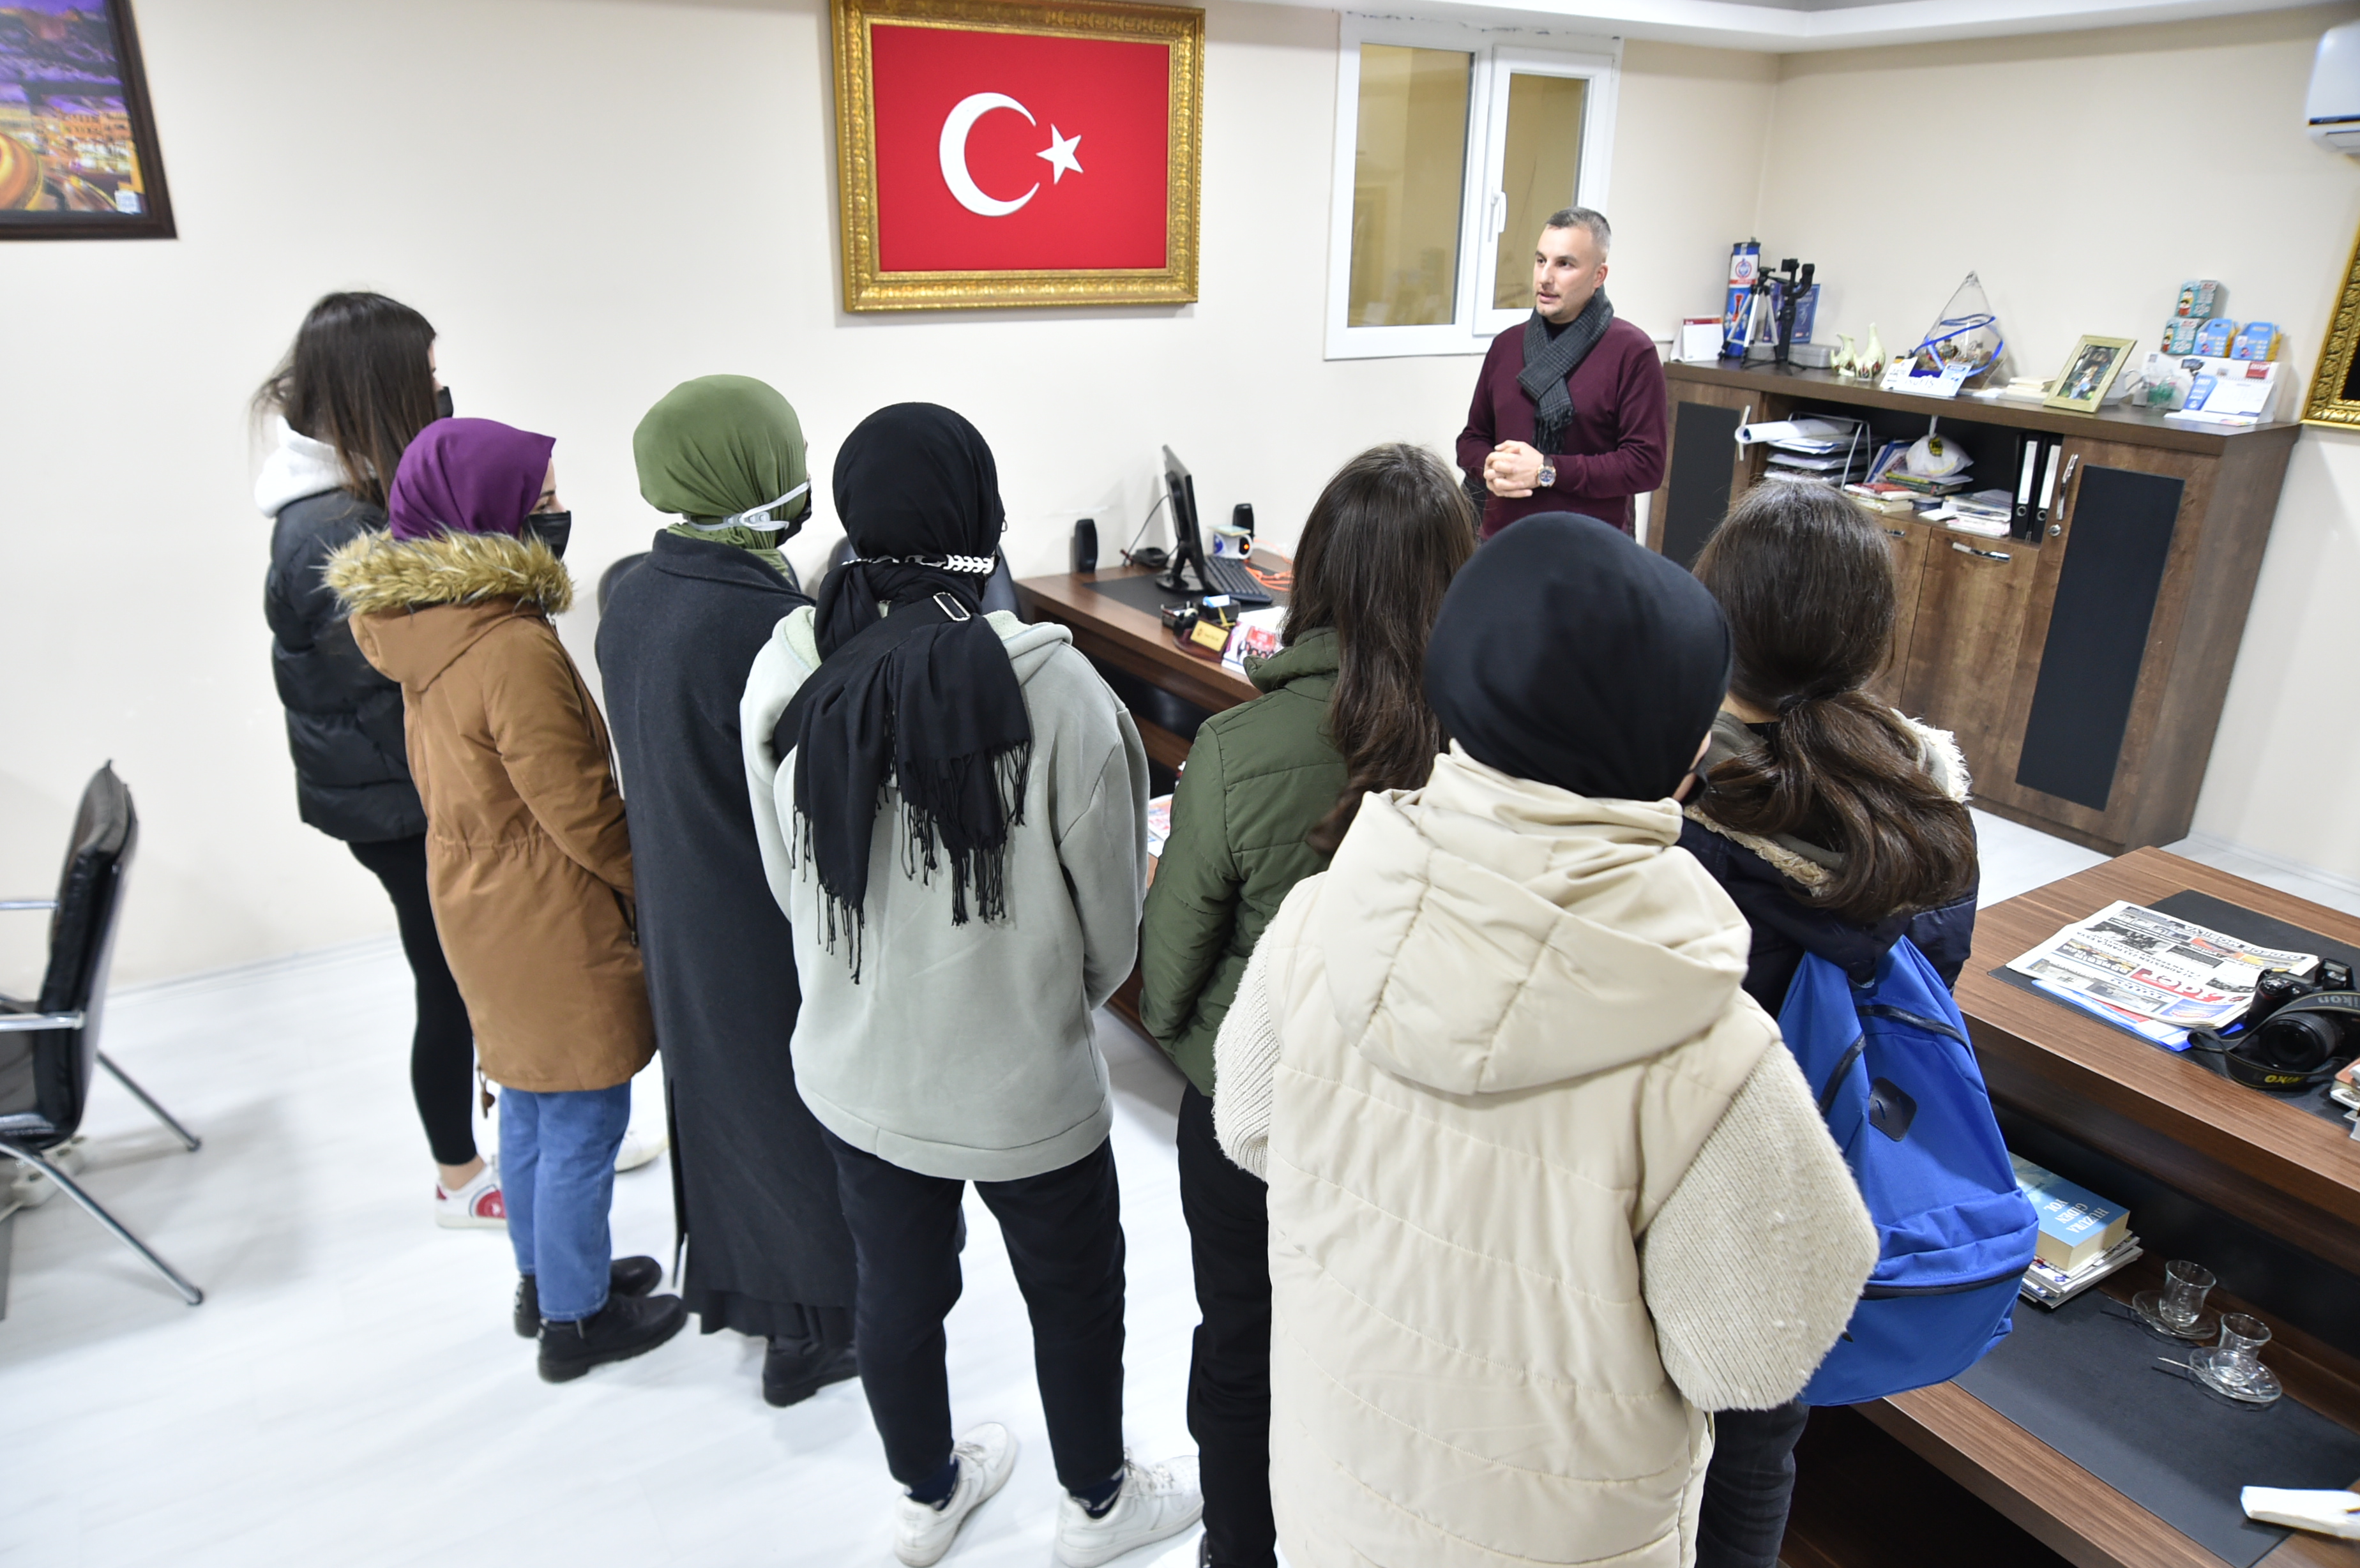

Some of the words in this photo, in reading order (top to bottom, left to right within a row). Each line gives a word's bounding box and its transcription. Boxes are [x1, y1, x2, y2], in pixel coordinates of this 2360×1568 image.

[2318, 995, 2360, 1007] ikon
[2044, 1198, 2069, 1212] YOL
[2055, 1203, 2089, 1224] GİDEN
[2066, 1207, 2110, 1233] HUZURA
